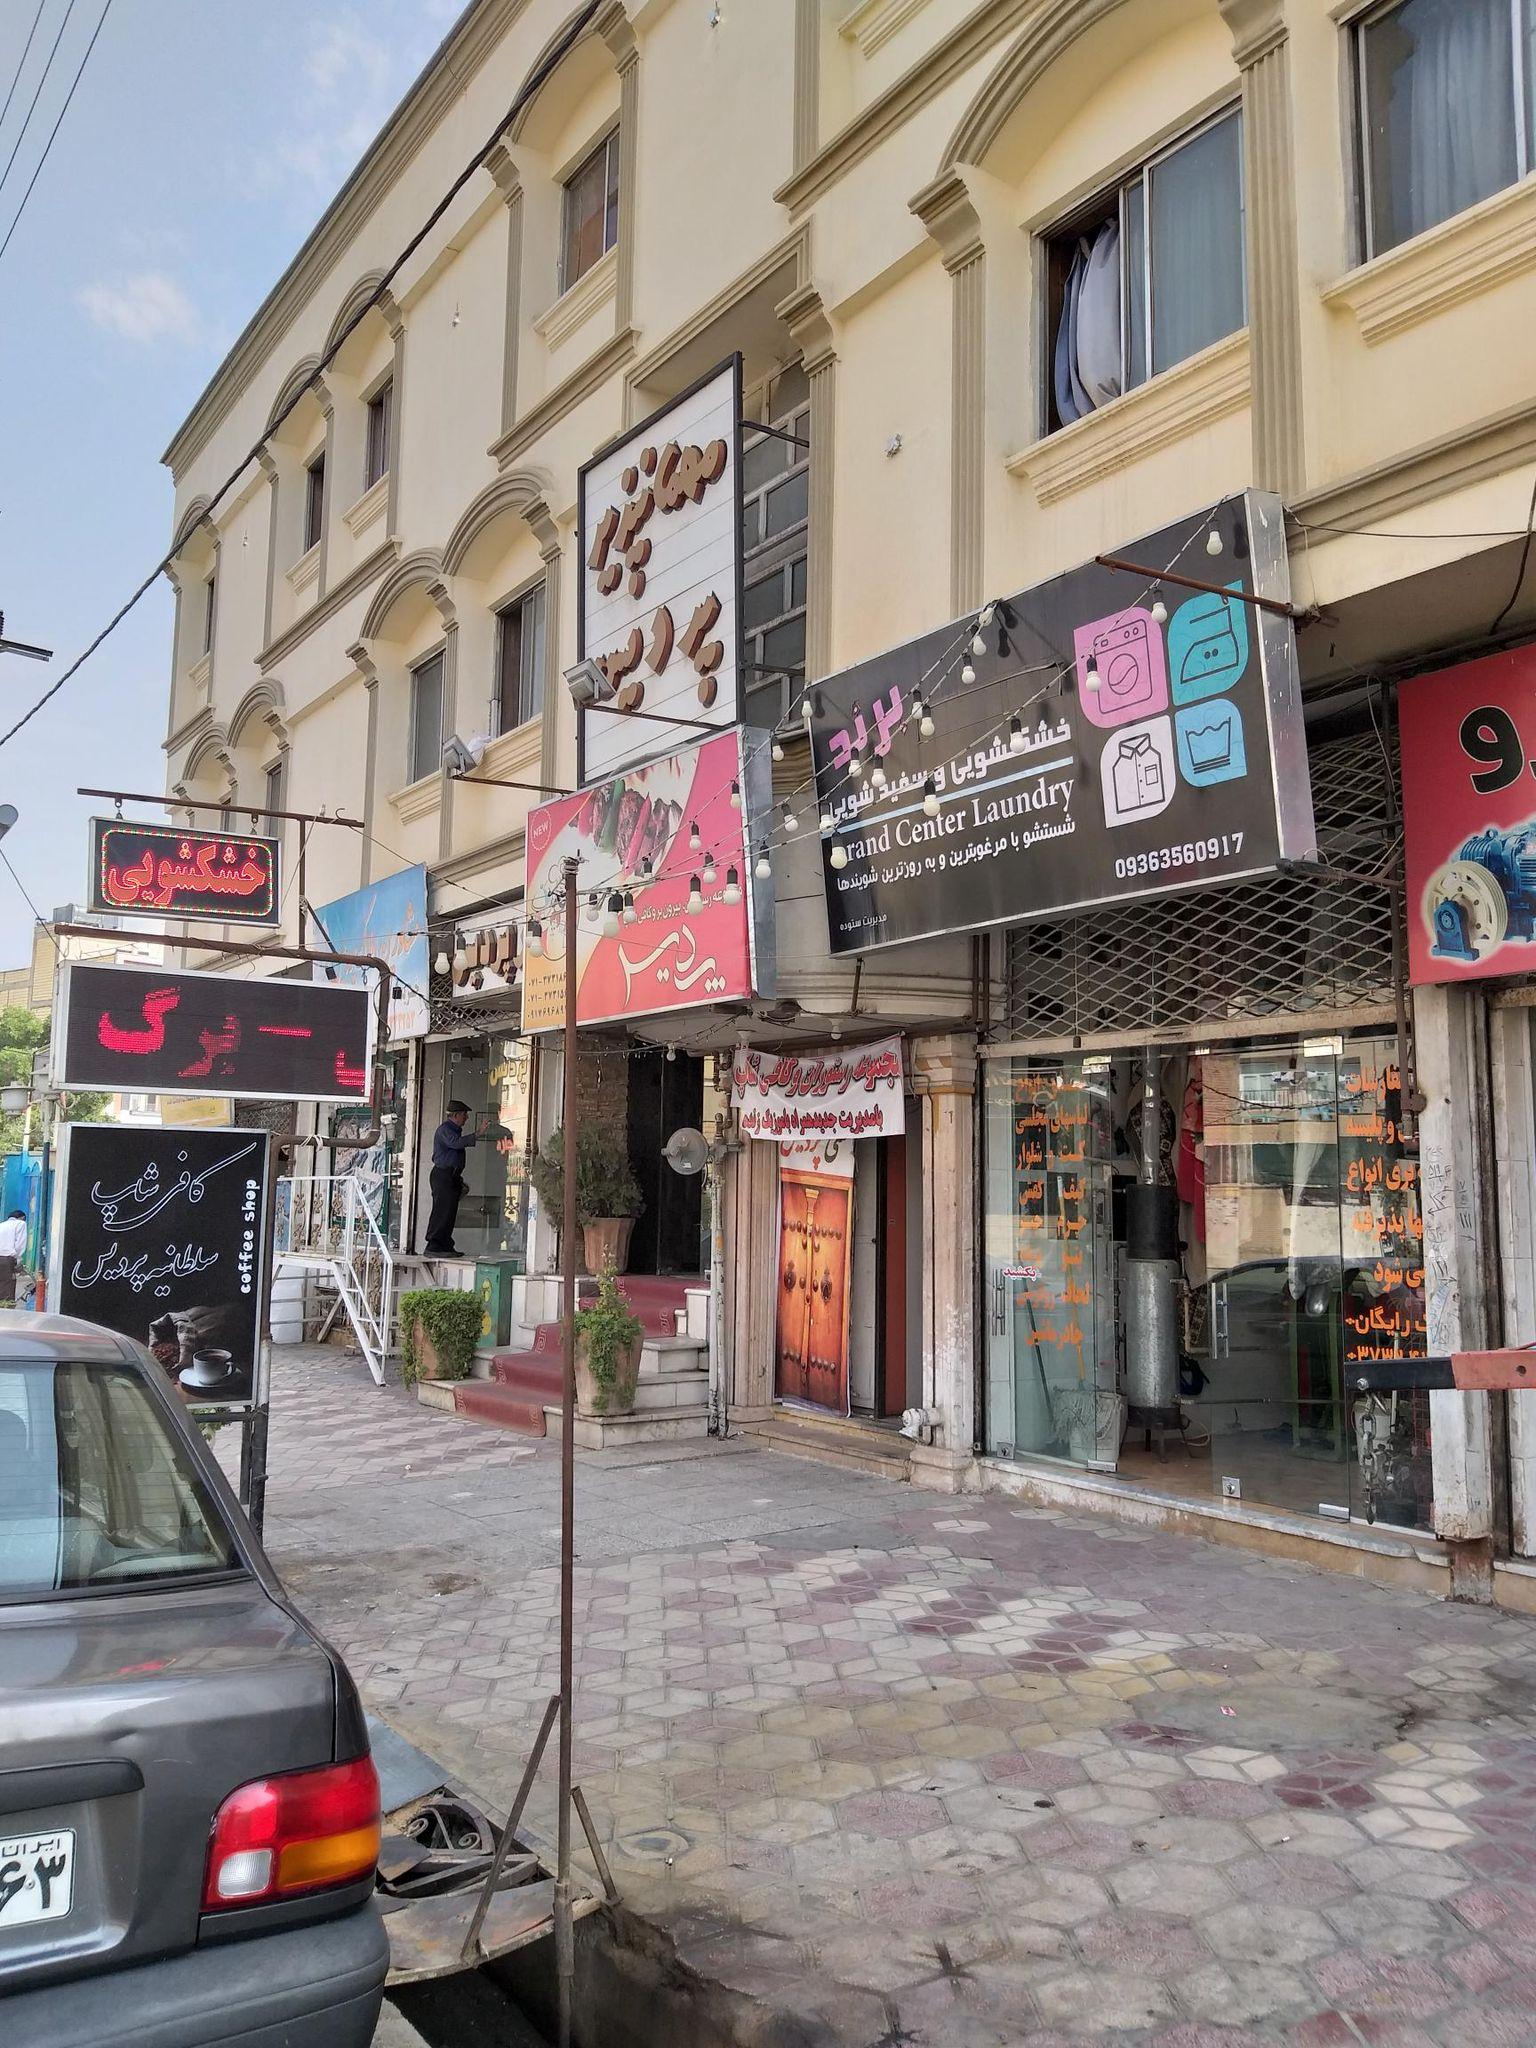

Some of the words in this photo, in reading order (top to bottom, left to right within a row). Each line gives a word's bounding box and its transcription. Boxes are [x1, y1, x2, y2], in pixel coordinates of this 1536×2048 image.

[828, 685, 903, 770] برند
[933, 767, 946, 791] و
[533, 821, 549, 838] NEW
[846, 824, 891, 862] rand
[895, 809, 966, 847] Center
[971, 777, 1075, 828] Laundry
[1023, 813, 1076, 849] شستشو
[1010, 831, 1019, 852] با
[1115, 832, 1244, 879] 09363560917
[108, 842, 266, 906] خشکشویی
[924, 856, 936, 872] به
[939, 854, 946, 868] و
[840, 919, 861, 931] ستوده
[862, 914, 887, 928] مدیریت
[91, 1163, 159, 1223] شاپ
[242, 1179, 260, 1222] shop
[238, 1230, 254, 1294] coffee
[1, 1838, 60, 1858] ایران
